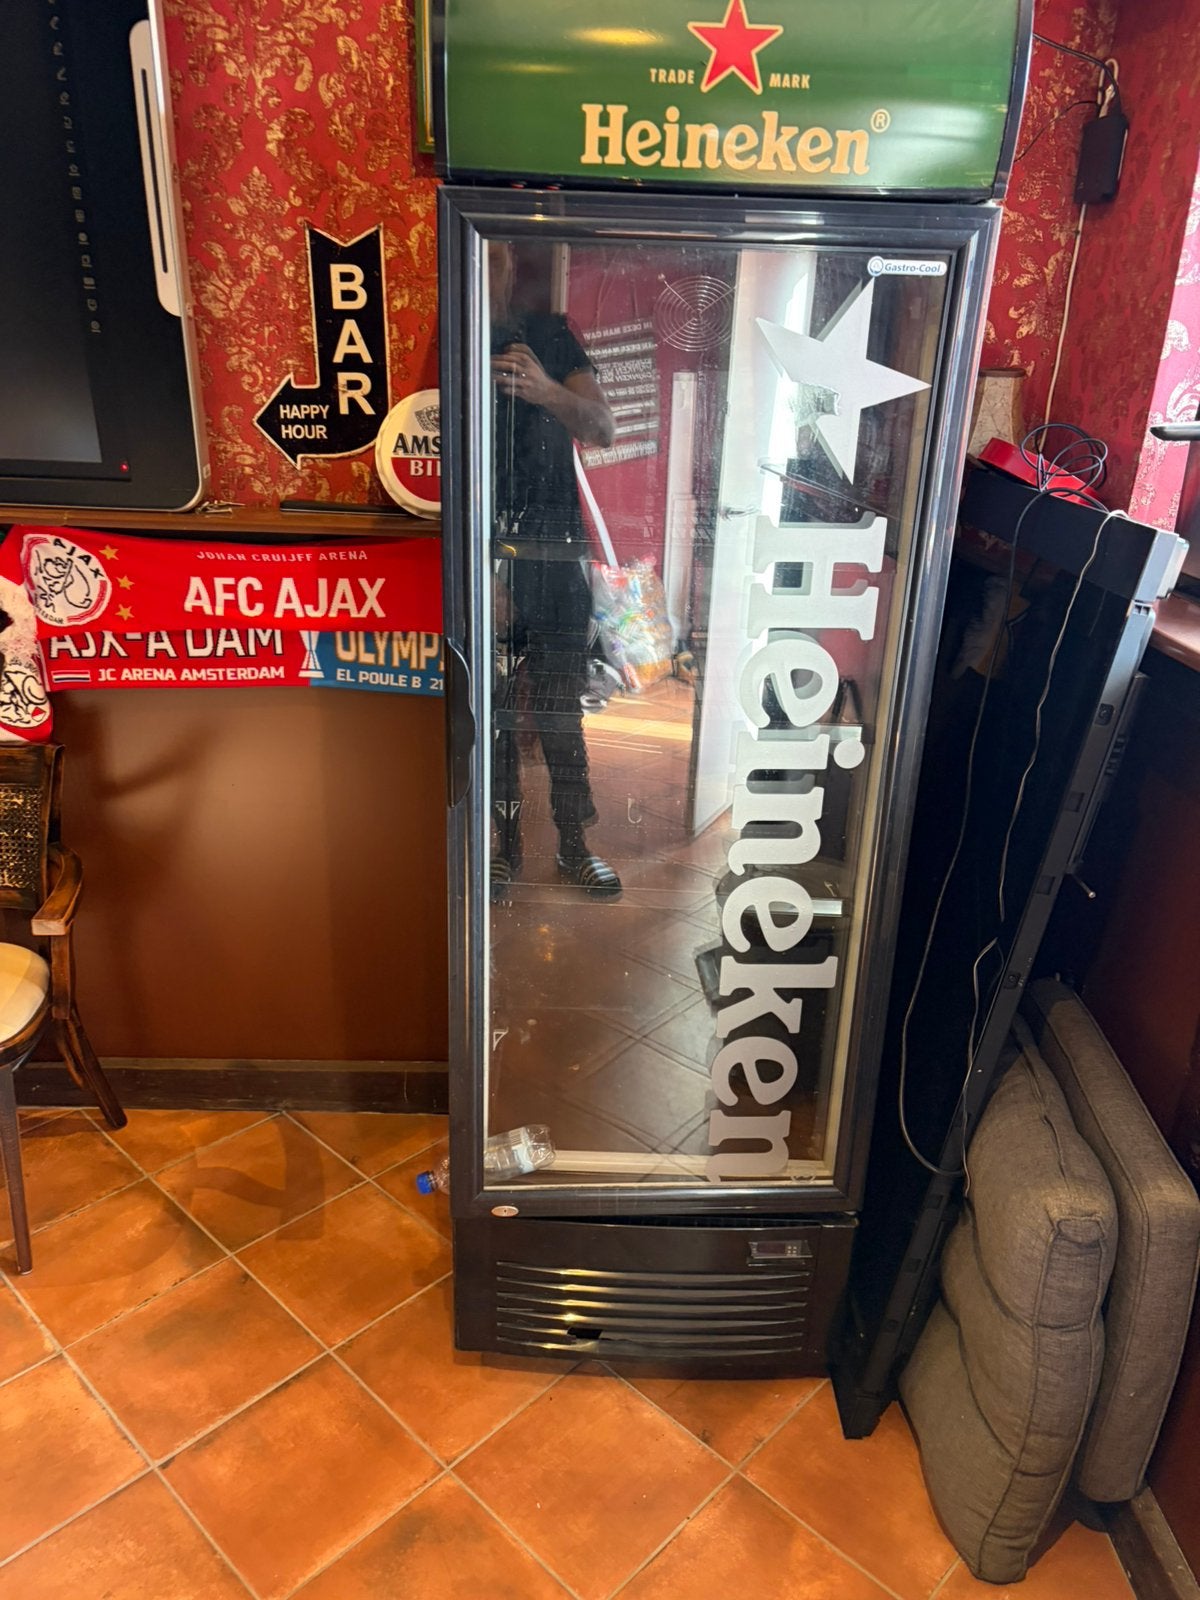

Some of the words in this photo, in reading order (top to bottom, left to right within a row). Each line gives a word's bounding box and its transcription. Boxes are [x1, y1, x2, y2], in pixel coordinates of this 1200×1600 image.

[650, 68, 695, 84] TRADE
[769, 73, 810, 89] MARK
[884, 262, 941, 273] Gastro-Cool
[329, 263, 376, 416] BAR
[279, 404, 330, 420] HAPPY
[281, 425, 328, 440] HOUR
[52, 538, 105, 579] AJAX
[196, 551, 247, 561] JOHAN
[251, 553, 313, 562] CRUIJFF
[318, 550, 368, 561] ARENA
[183, 576, 265, 617] AFC
[274, 577, 386, 619] AJAX
[98, 668, 117, 681] JC
[121, 667, 174, 681] ARENA
[180, 666, 285, 681] AMSTERDAM
[336, 668, 355, 682] EL
[358, 671, 407, 687] POULE
[411, 676, 422, 689] B
[706, 512, 888, 1184] Heineken
